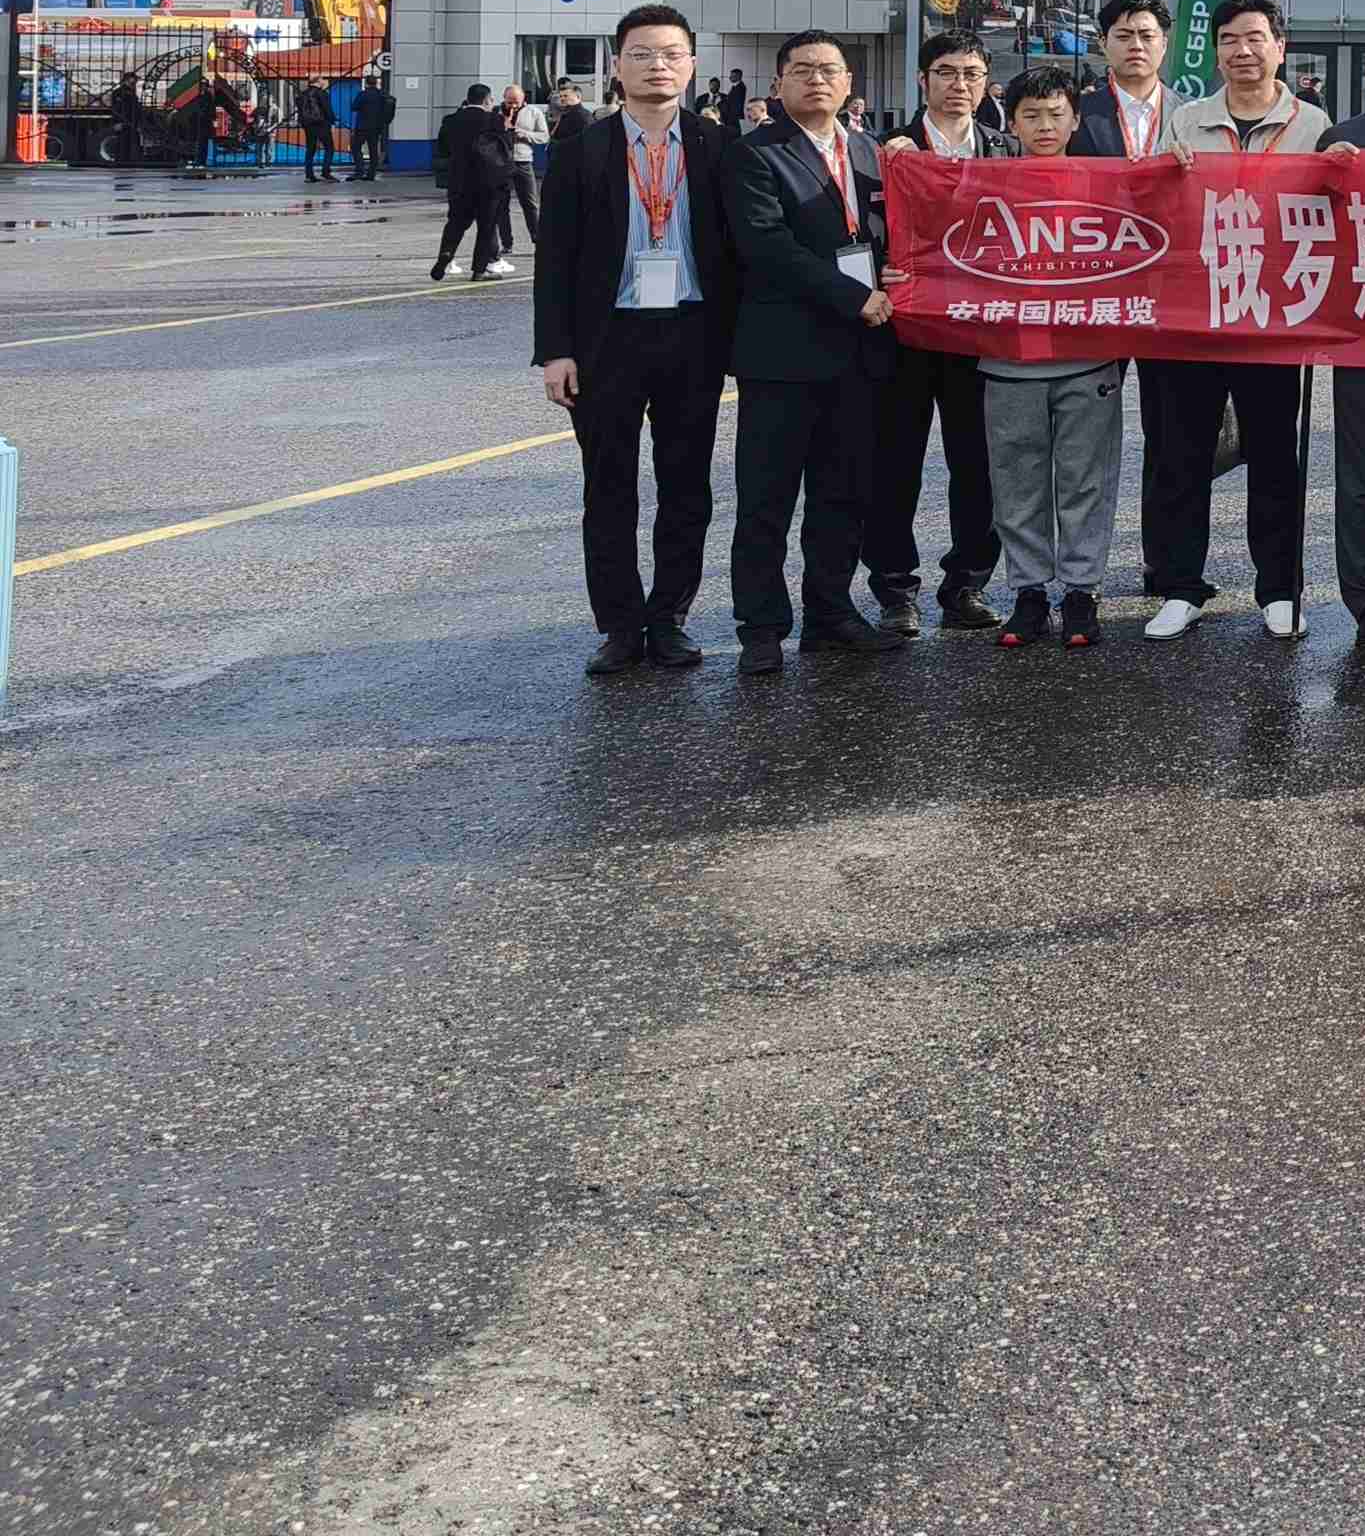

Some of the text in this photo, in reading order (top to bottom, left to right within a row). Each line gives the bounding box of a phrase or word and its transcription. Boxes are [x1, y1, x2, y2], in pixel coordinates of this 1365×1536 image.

[1184, 1, 1210, 68] СБЕР
[960, 196, 1151, 262] ANSA
[998, 260, 1115, 273] EXHIBITION
[946, 296, 1158, 326] 安萨国际展览
